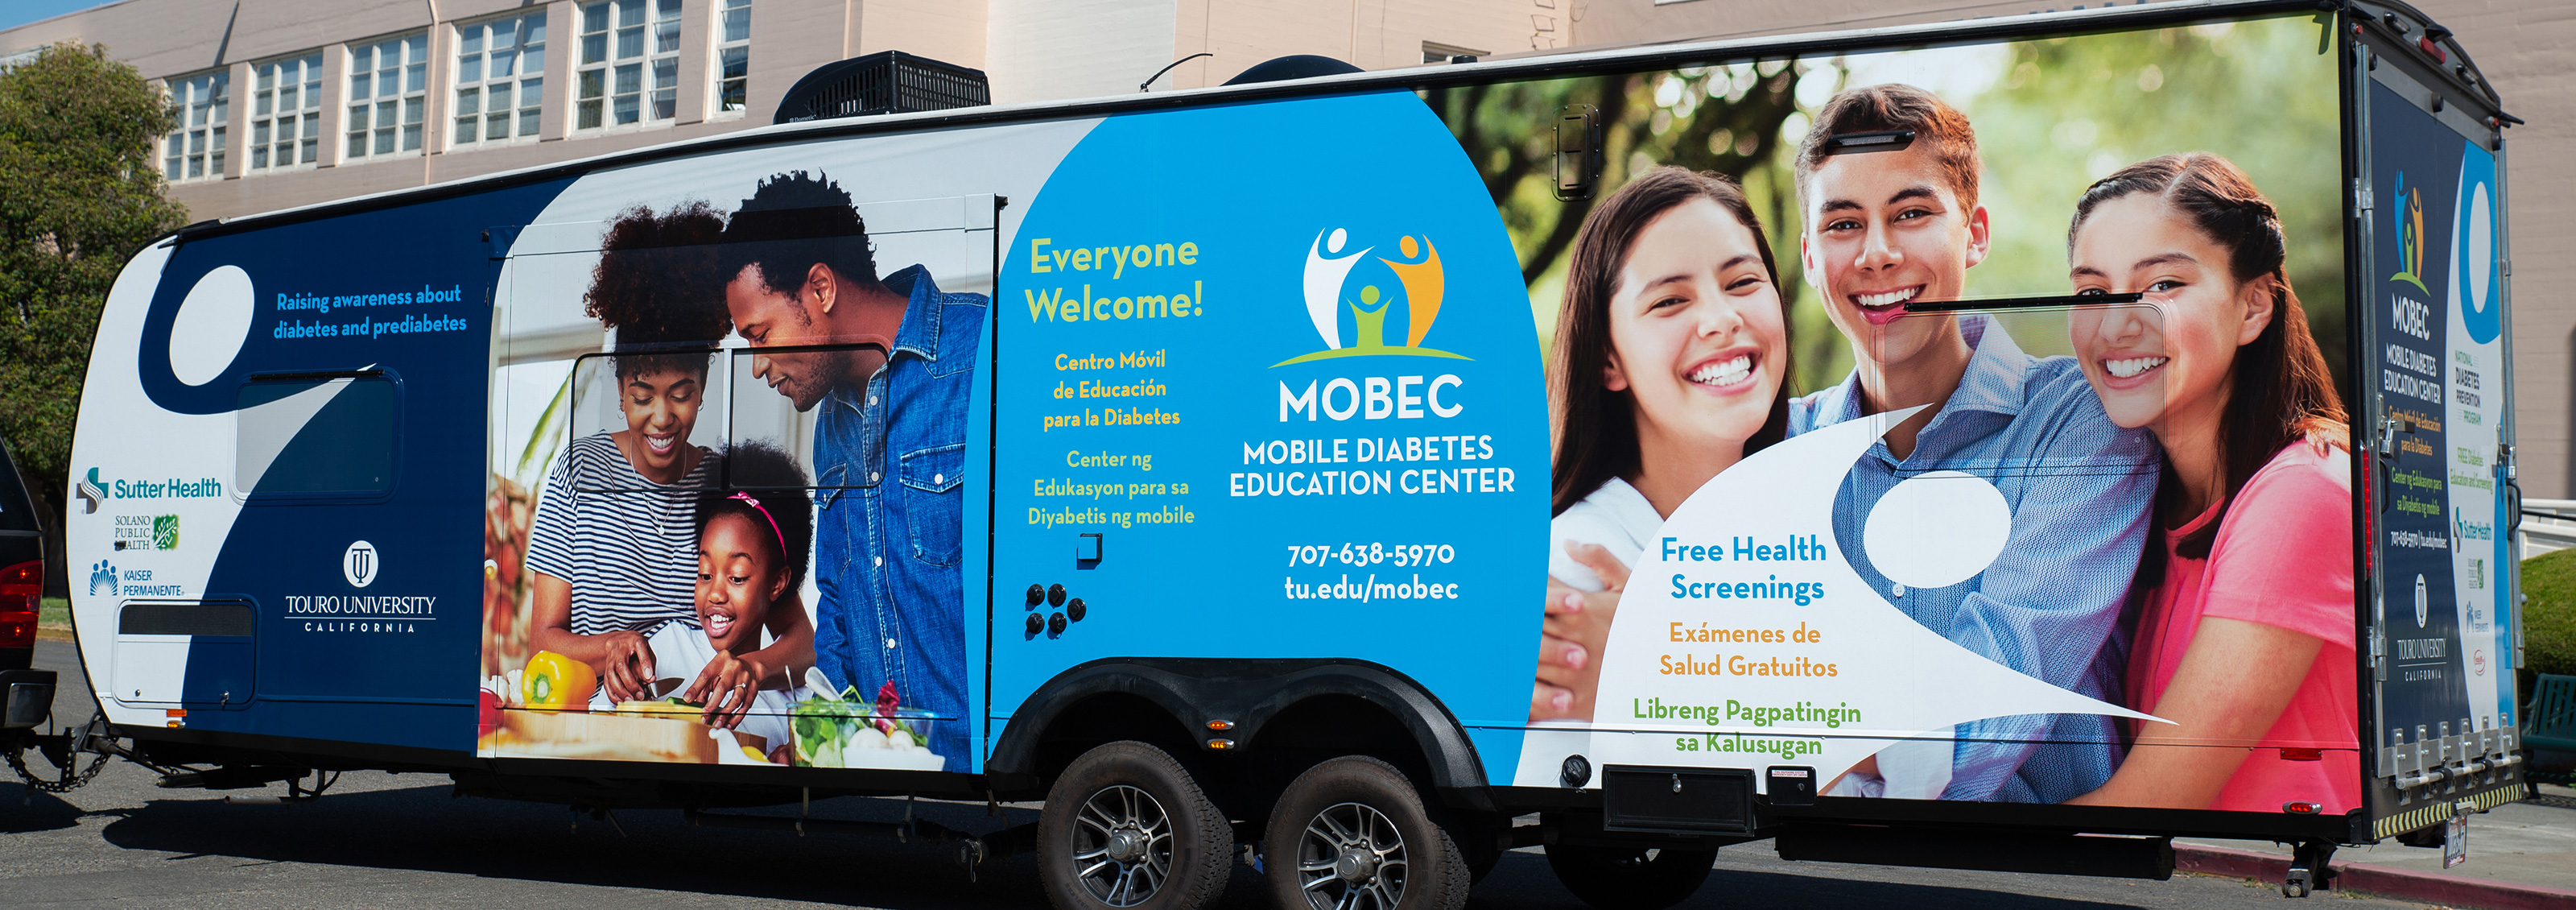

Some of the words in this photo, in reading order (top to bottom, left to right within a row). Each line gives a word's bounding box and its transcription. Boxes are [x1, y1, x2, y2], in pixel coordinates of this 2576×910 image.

[1030, 238, 1199, 279] Everyone
[277, 292, 330, 313] Raising
[332, 291, 412, 308] awareness
[416, 284, 461, 304] about
[1024, 280, 1203, 324] Welcome!
[274, 319, 338, 339] diabetes
[341, 316, 369, 337] and
[374, 313, 467, 340] prediabetes
[2392, 292, 2430, 341] MOBEC
[1055, 353, 1115, 371] Centro
[1120, 350, 1166, 369] Móvil
[2386, 342, 2409, 370] MOBILE
[2409, 350, 2437, 378] DIABETES
[1053, 381, 1074, 399] de
[1080, 378, 1166, 398] Educación
[2384, 369, 2418, 398] EDUCATION
[2419, 379, 2442, 404] CENTER
[2455, 366, 2480, 391] DIABETES
[1279, 374, 1463, 423] MOBEC
[2456, 388, 2481, 408] PREVENTION
[1044, 413, 1080, 432] para
[1085, 408, 1099, 426] la
[1104, 407, 1180, 426] Diabetes
[1067, 450, 1127, 468] Center
[1132, 453, 1152, 472] ng
[1244, 438, 1348, 465] MOBILE
[1357, 435, 1494, 462] DIABETES
[1230, 470, 1391, 497] EDUCATION
[1400, 467, 1515, 494] CENTER
[2392, 466, 2407, 485] Center
[114, 478, 166, 498] Sutter
[168, 478, 221, 498] Health
[1034, 478, 1124, 500] Edukasyon
[1129, 482, 1166, 500] para
[1171, 482, 1189, 495] sa
[115, 515, 151, 526] SOLANO
[1028, 507, 1107, 529] Diyabetis
[1112, 511, 1132, 528] ng
[1136, 505, 1195, 524] mobile
[114, 527, 151, 538] PUBLIC
[2464, 519, 2478, 539] Sutter
[2478, 522, 2492, 541] Health
[1287, 542, 1455, 567] 707-638-5970
[1662, 536, 1724, 561] Free
[1733, 534, 1827, 561] Health
[124, 570, 152, 581] KAISER
[123, 585, 182, 596] PERMANENTE
[1285, 573, 1459, 603] tu.edu/mobec
[1670, 573, 1824, 606] Screenings
[285, 595, 340, 614] TOURO
[343, 596, 436, 614] UNIVERSITY
[304, 622, 415, 633] CALIFORNIA
[1670, 622, 1785, 643] Exámenes
[1792, 622, 1821, 643] de
[2397, 639, 2416, 660] TOURO
[2416, 638, 2446, 659] UNIVERSITY
[1660, 654, 1720, 676] Salud
[1728, 656, 1838, 677] Gratuitos
[2405, 669, 2442, 682] CALIFORNIA
[1634, 697, 1719, 726] Libreng
[1726, 699, 1861, 728] Pagpatingin
[1675, 735, 1699, 751] sa
[1706, 731, 1822, 759] Kalusugan
